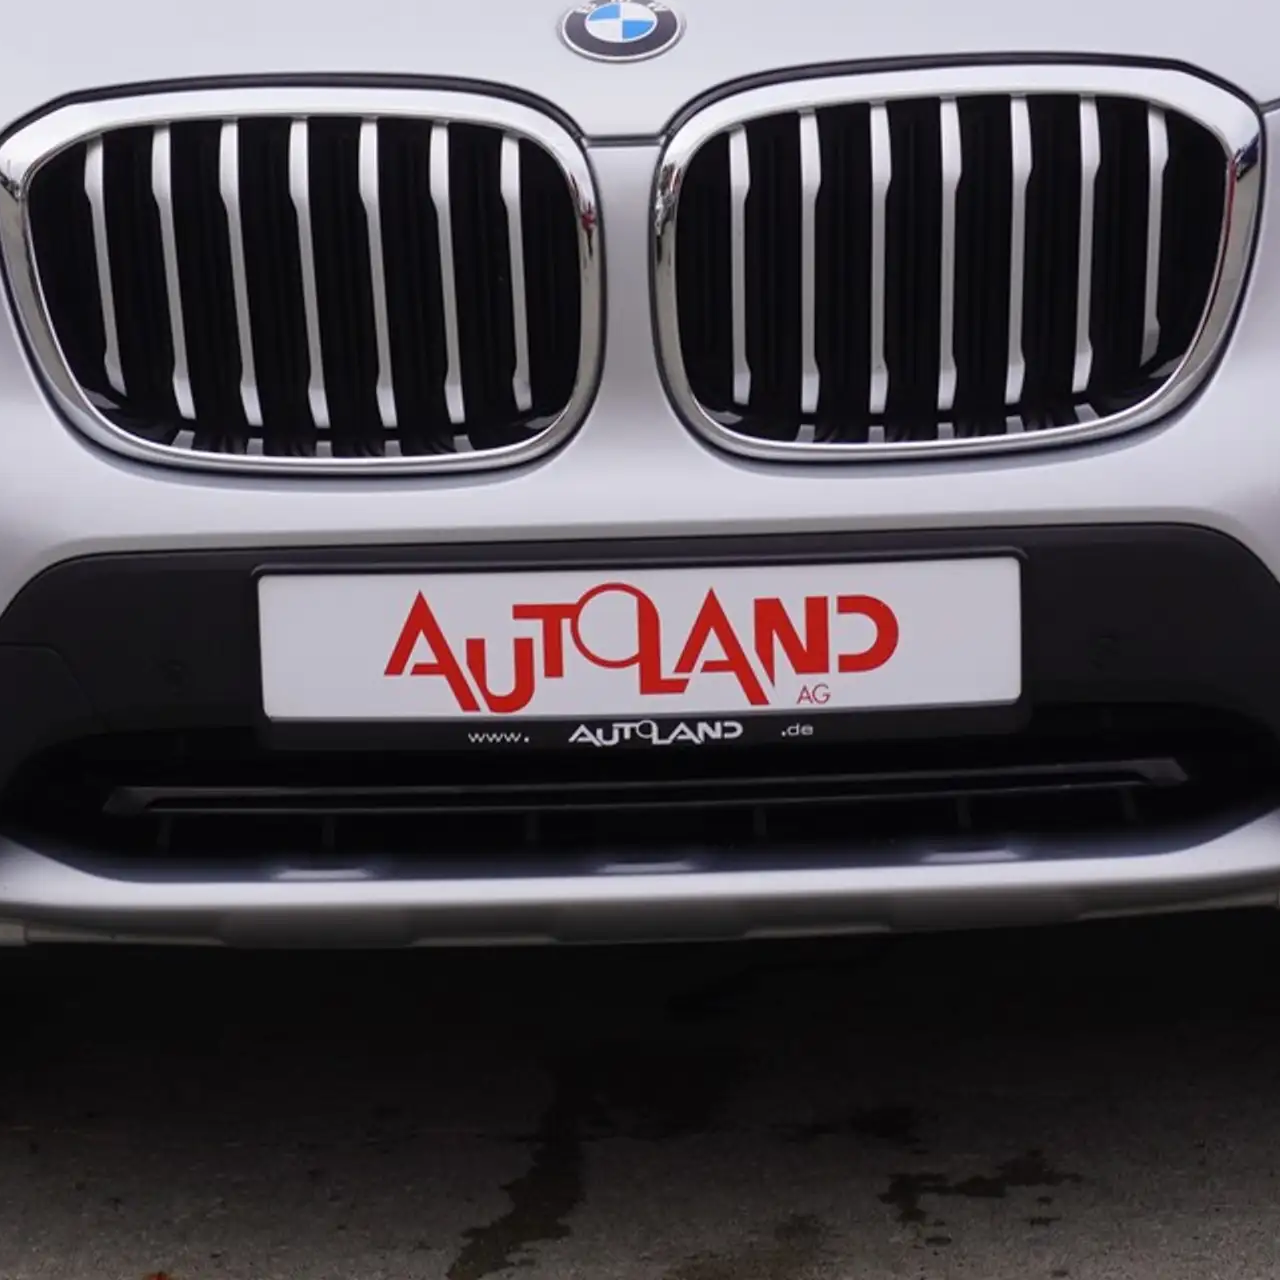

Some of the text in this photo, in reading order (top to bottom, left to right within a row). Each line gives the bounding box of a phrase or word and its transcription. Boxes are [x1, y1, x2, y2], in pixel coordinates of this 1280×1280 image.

[384, 582, 900, 714] AUTOLAND
[797, 684, 831, 706] AG
[467, 720, 814, 747] www. AUTOLAND .de
